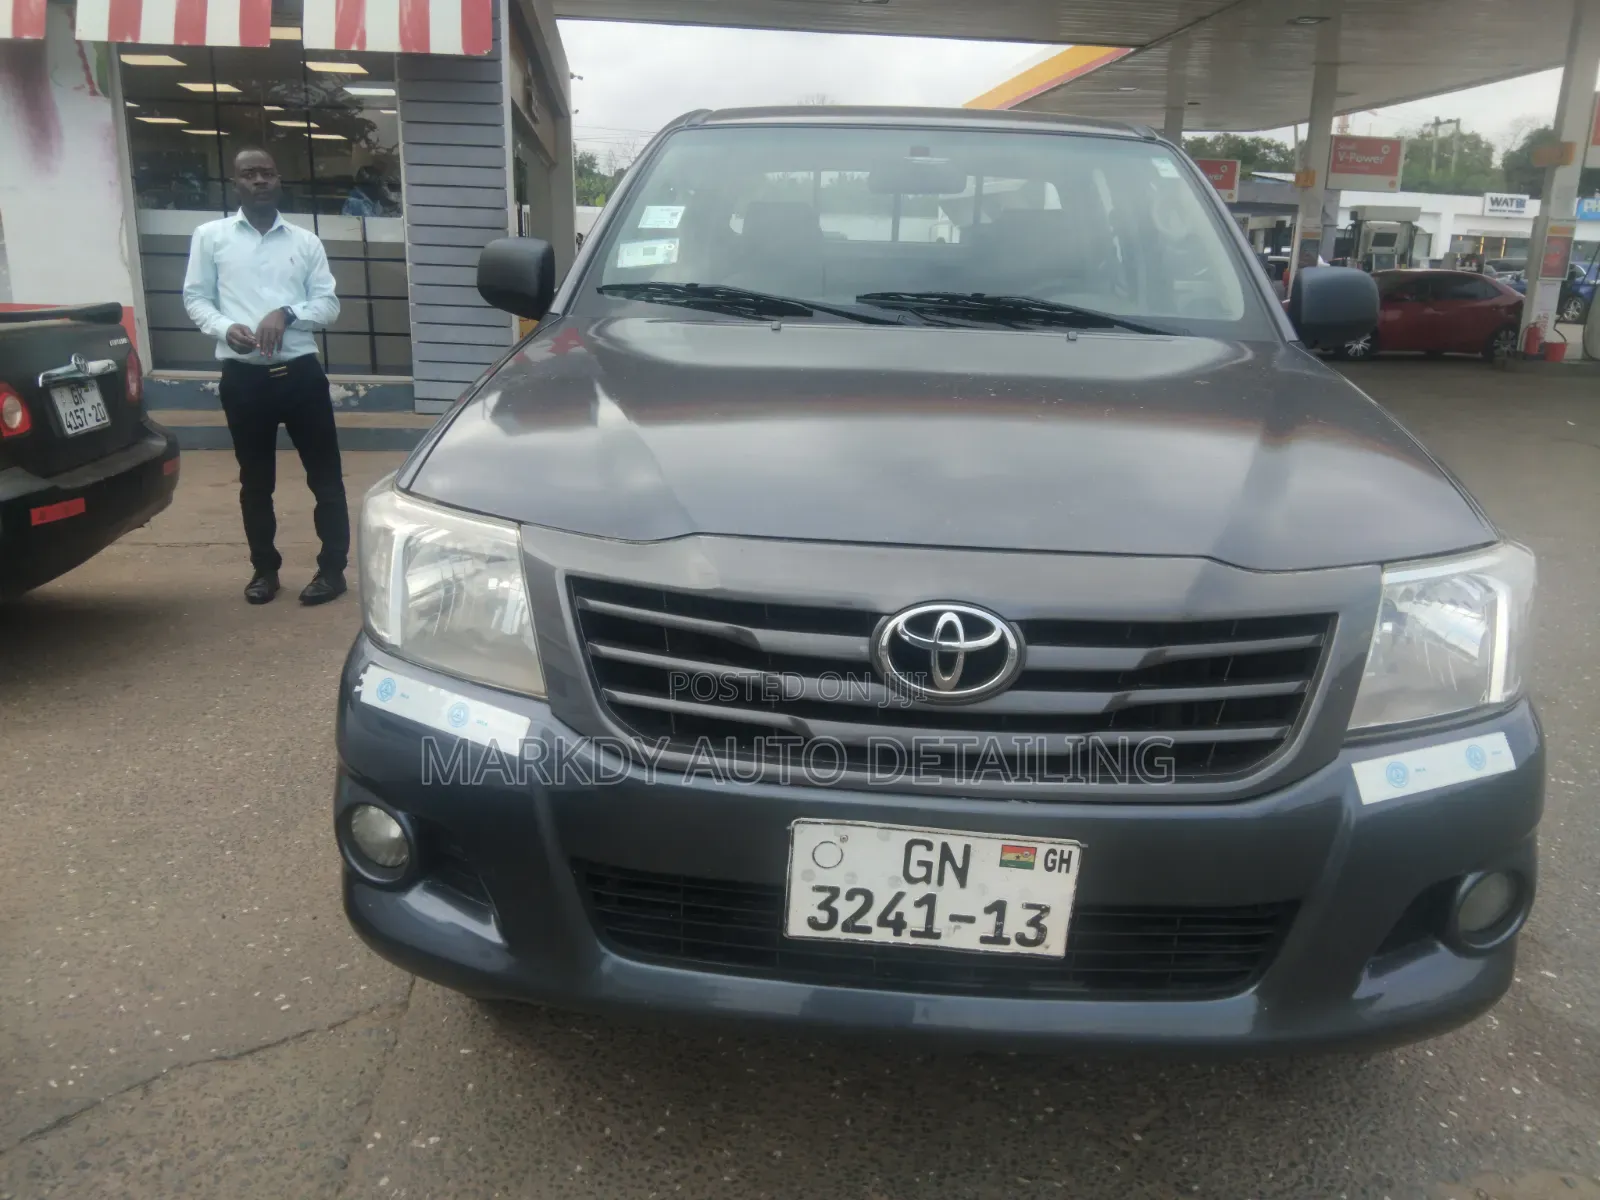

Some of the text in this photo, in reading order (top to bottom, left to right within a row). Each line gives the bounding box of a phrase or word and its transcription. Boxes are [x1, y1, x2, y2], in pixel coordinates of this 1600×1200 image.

[1337, 150, 1385, 165] V-Power
[65, 402, 107, 431] 4157-20
[902, 838, 1073, 889] GN GH
[806, 884, 1051, 948] 3241-13
